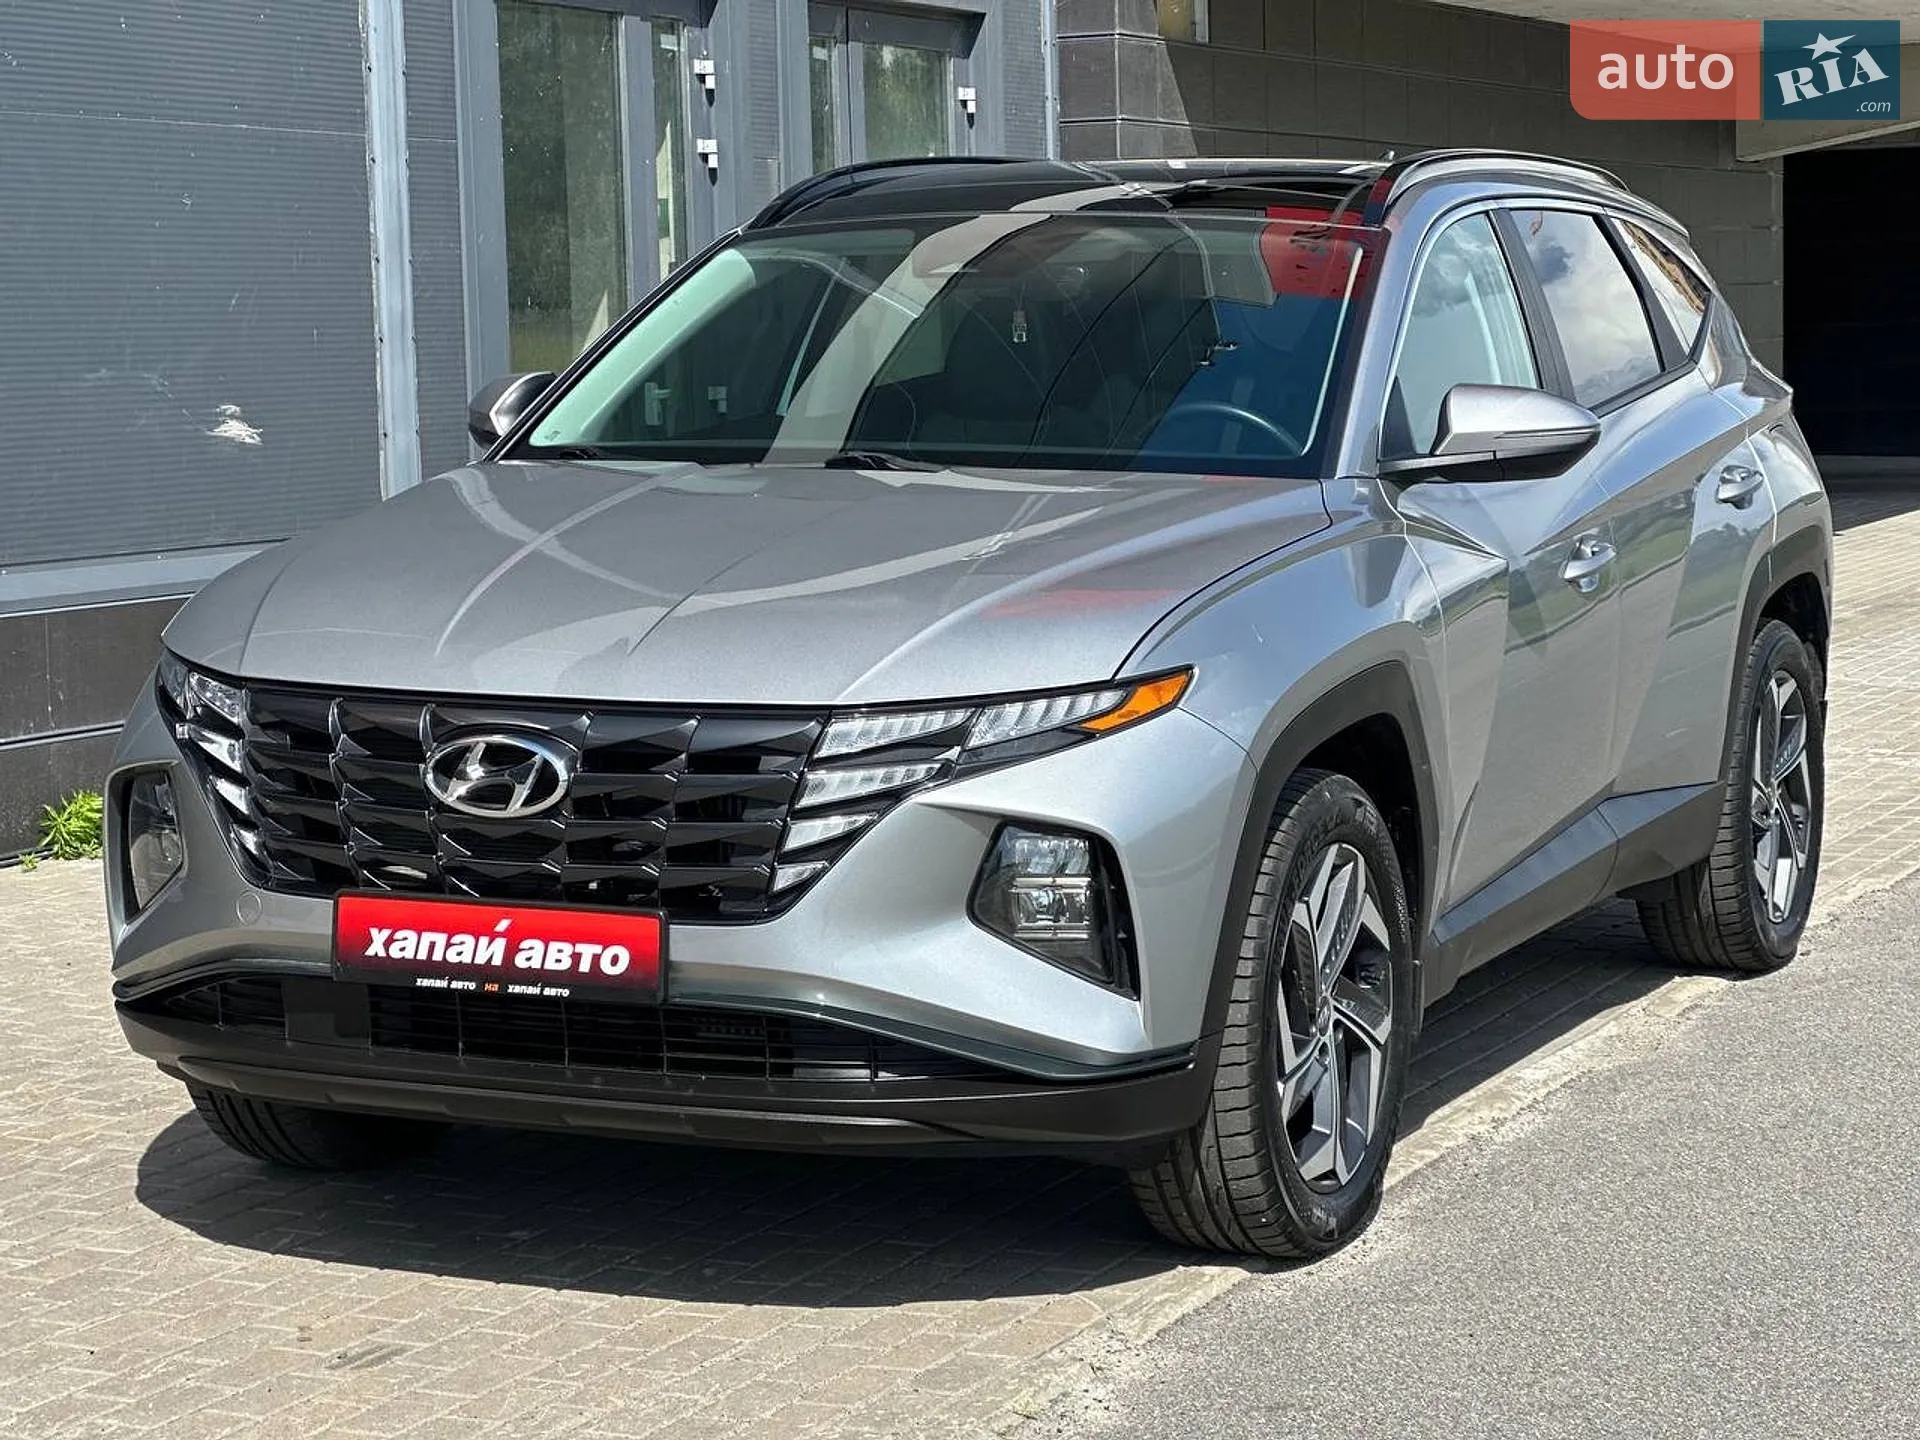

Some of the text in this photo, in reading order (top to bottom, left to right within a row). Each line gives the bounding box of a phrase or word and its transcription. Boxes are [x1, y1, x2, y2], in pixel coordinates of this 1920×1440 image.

[514, 938, 631, 976] авто
[449, 980, 477, 991] авто
[484, 983, 500, 992] на
[542, 986, 571, 998] авто
